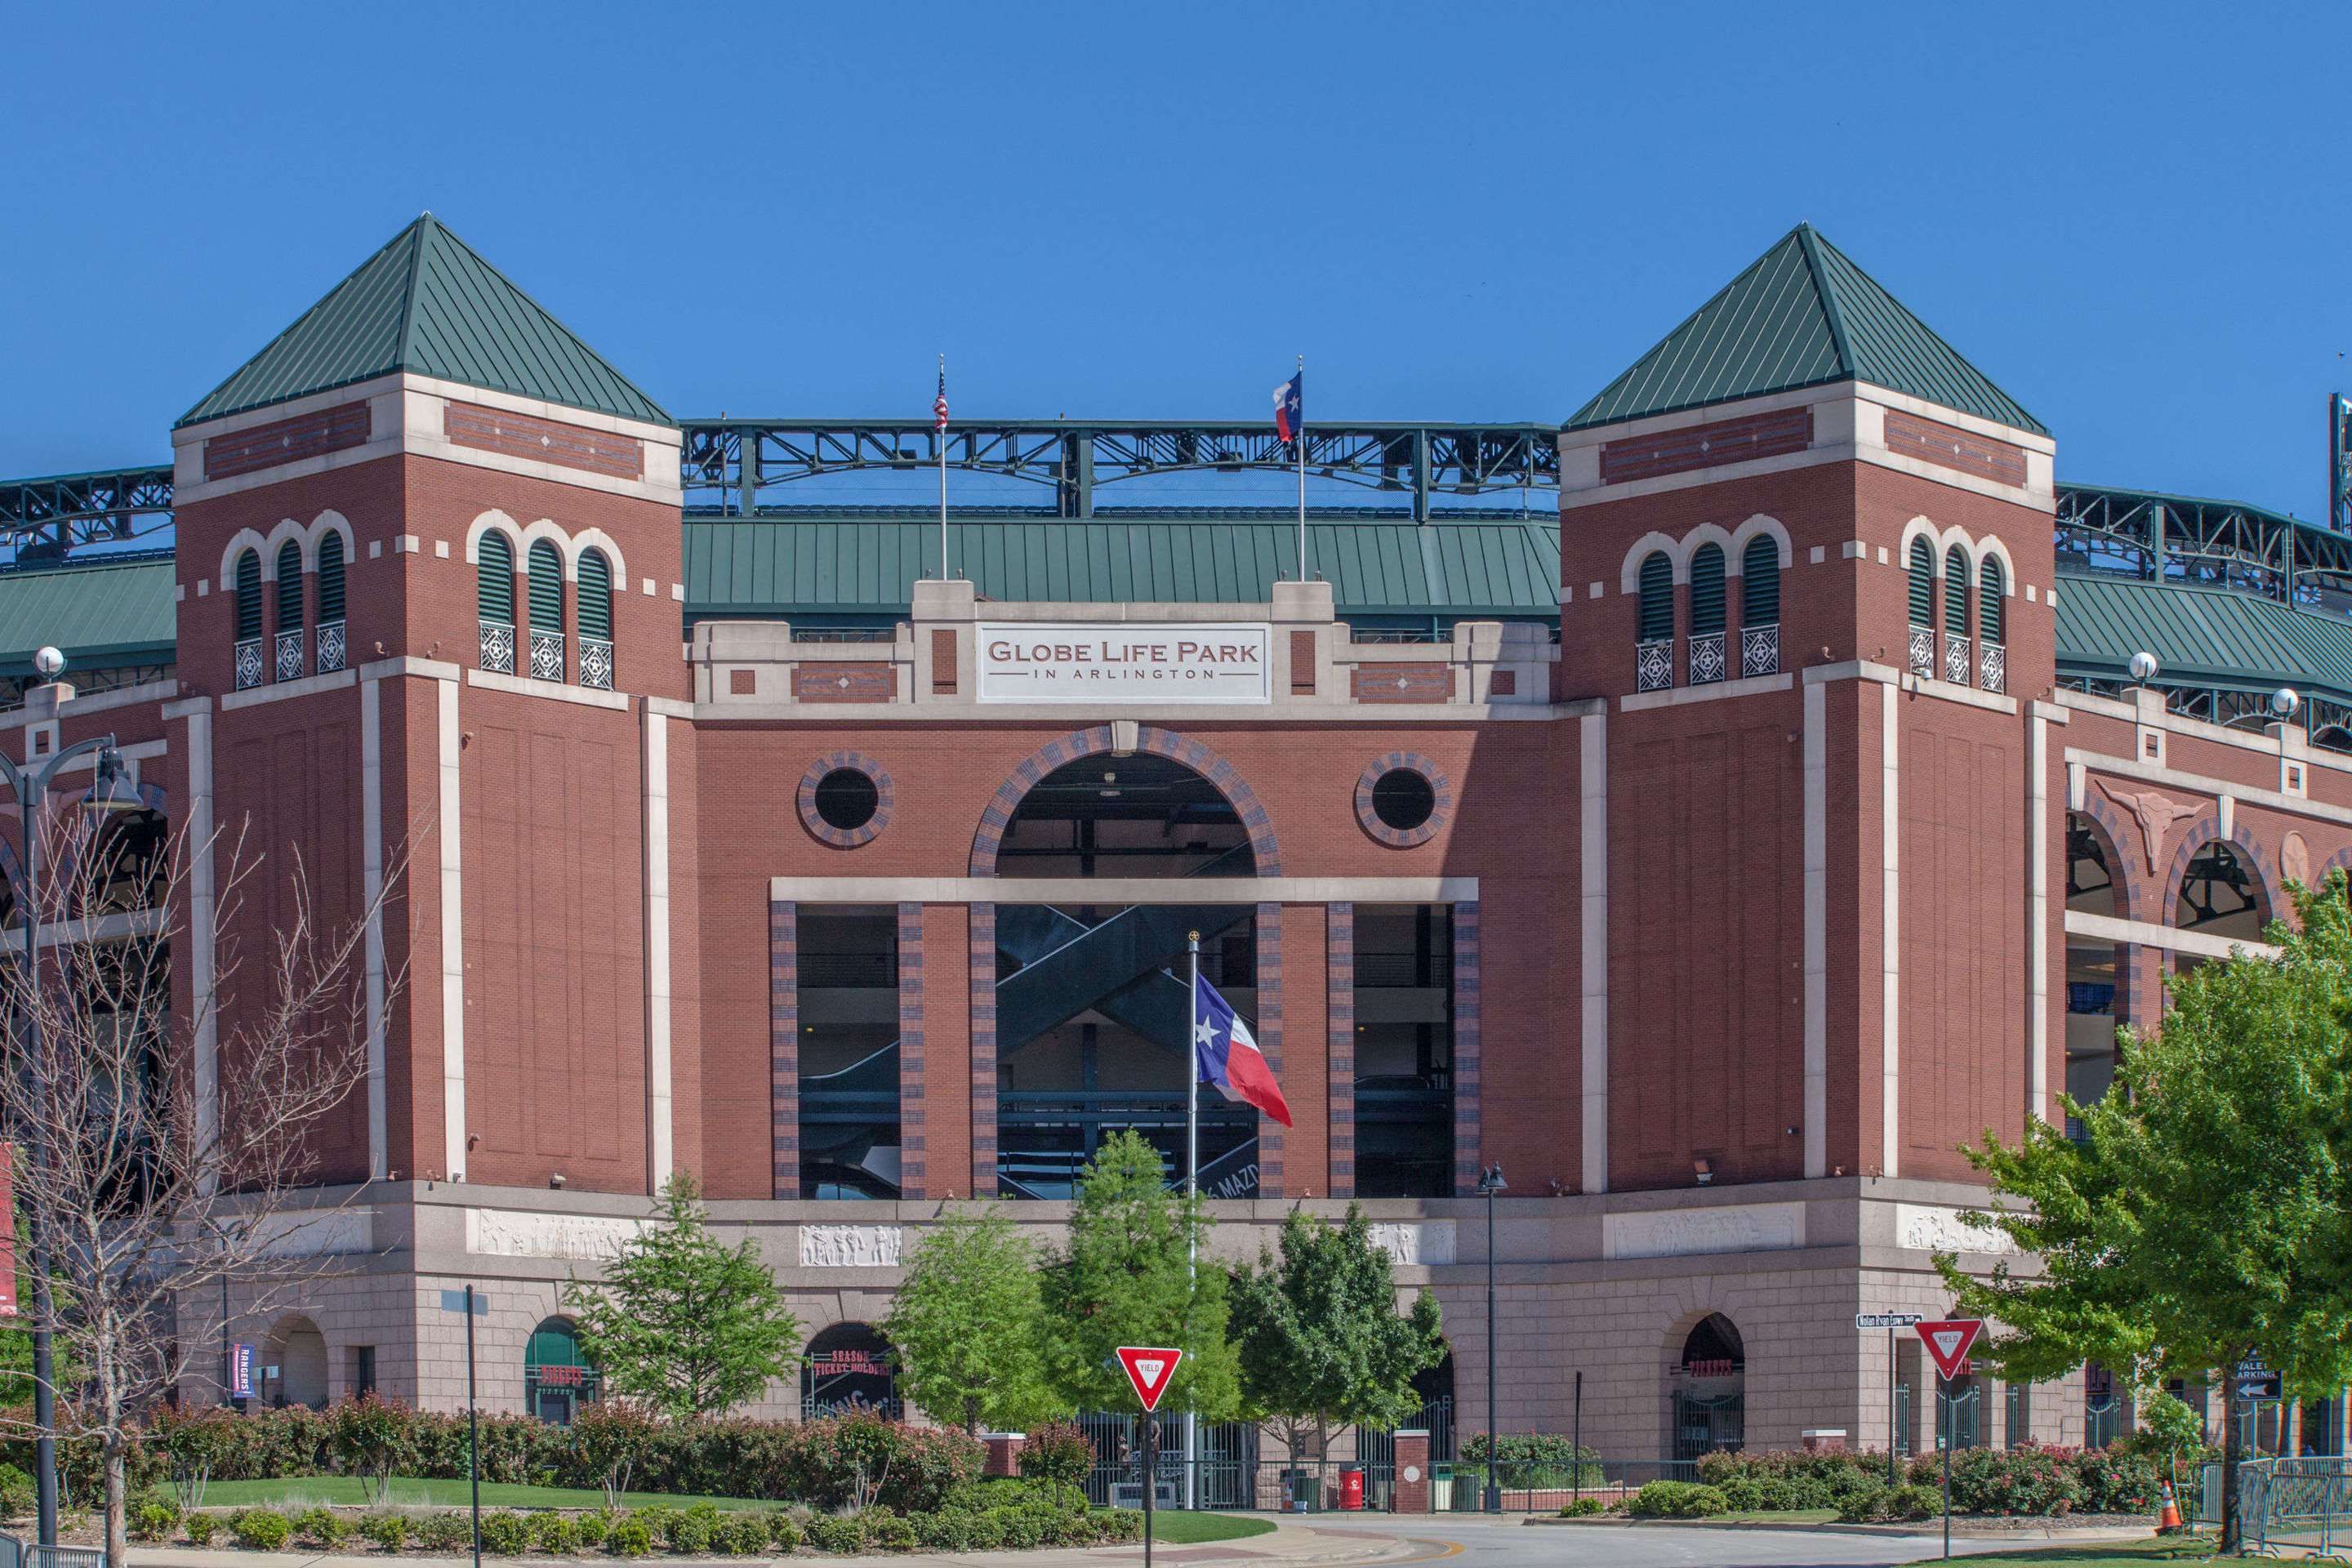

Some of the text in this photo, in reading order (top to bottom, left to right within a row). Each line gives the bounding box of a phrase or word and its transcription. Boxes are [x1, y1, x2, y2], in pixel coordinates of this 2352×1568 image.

[988, 641, 1258, 662] GLOBE LIFE PARK
[1034, 670, 1214, 679] IN ARLINGTON
[1859, 1315, 1875, 1326] Nolan
[1876, 1315, 1889, 1326] Ryan
[831, 1350, 870, 1362] SEASON
[240, 1349, 250, 1390] RANGERS
[813, 1362, 890, 1379] TICKET HOLDERS
[1140, 1364, 1160, 1372] YIELD
[2238, 1370, 2275, 1379] ARKING
